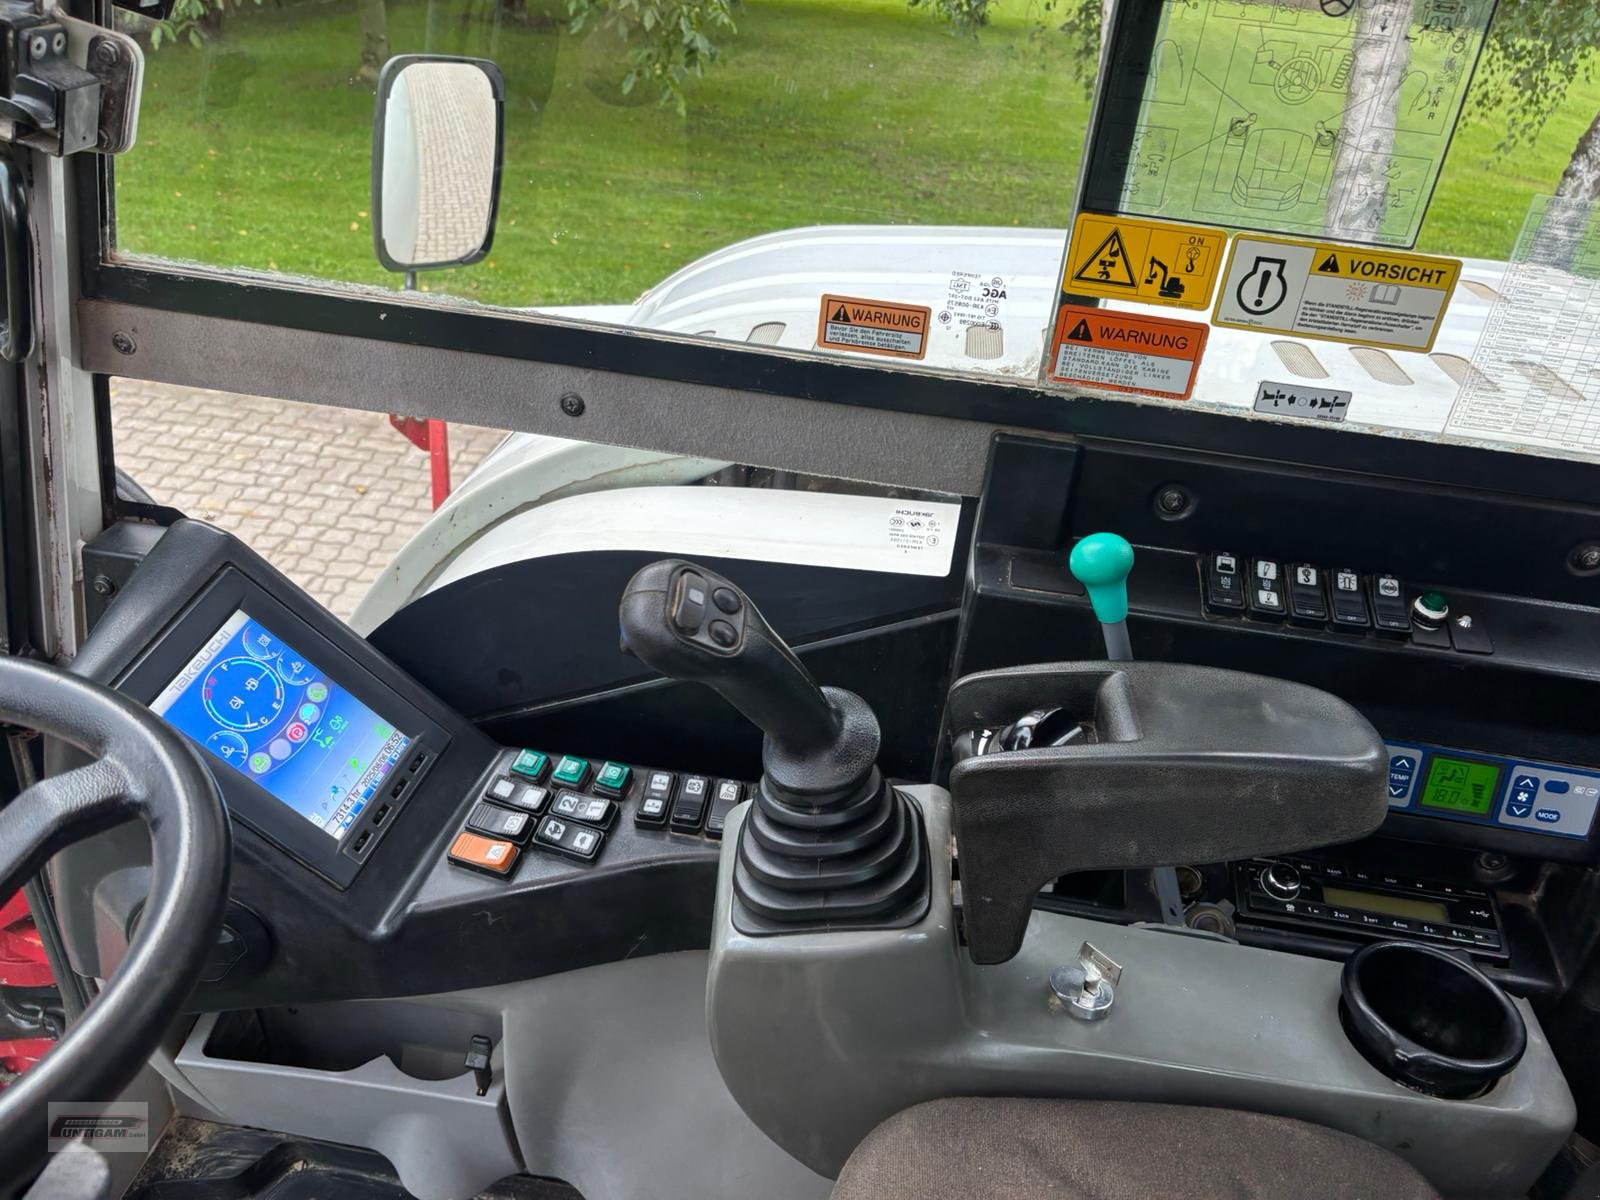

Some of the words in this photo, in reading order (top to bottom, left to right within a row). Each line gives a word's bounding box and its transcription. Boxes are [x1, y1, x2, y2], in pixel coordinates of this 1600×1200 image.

[1188, 235, 1205, 245] ON
[1350, 259, 1446, 284] VORSICHT
[852, 308, 921, 328] WARNUNG
[1099, 325, 1188, 350] WARNUNG
[332, 796, 355, 824] 7314.3
[350, 788, 362, 799] hr
[384, 732, 402, 755] 06:52
[1389, 772, 1409, 782] TEMP
[1537, 810, 1558, 821] MODE
